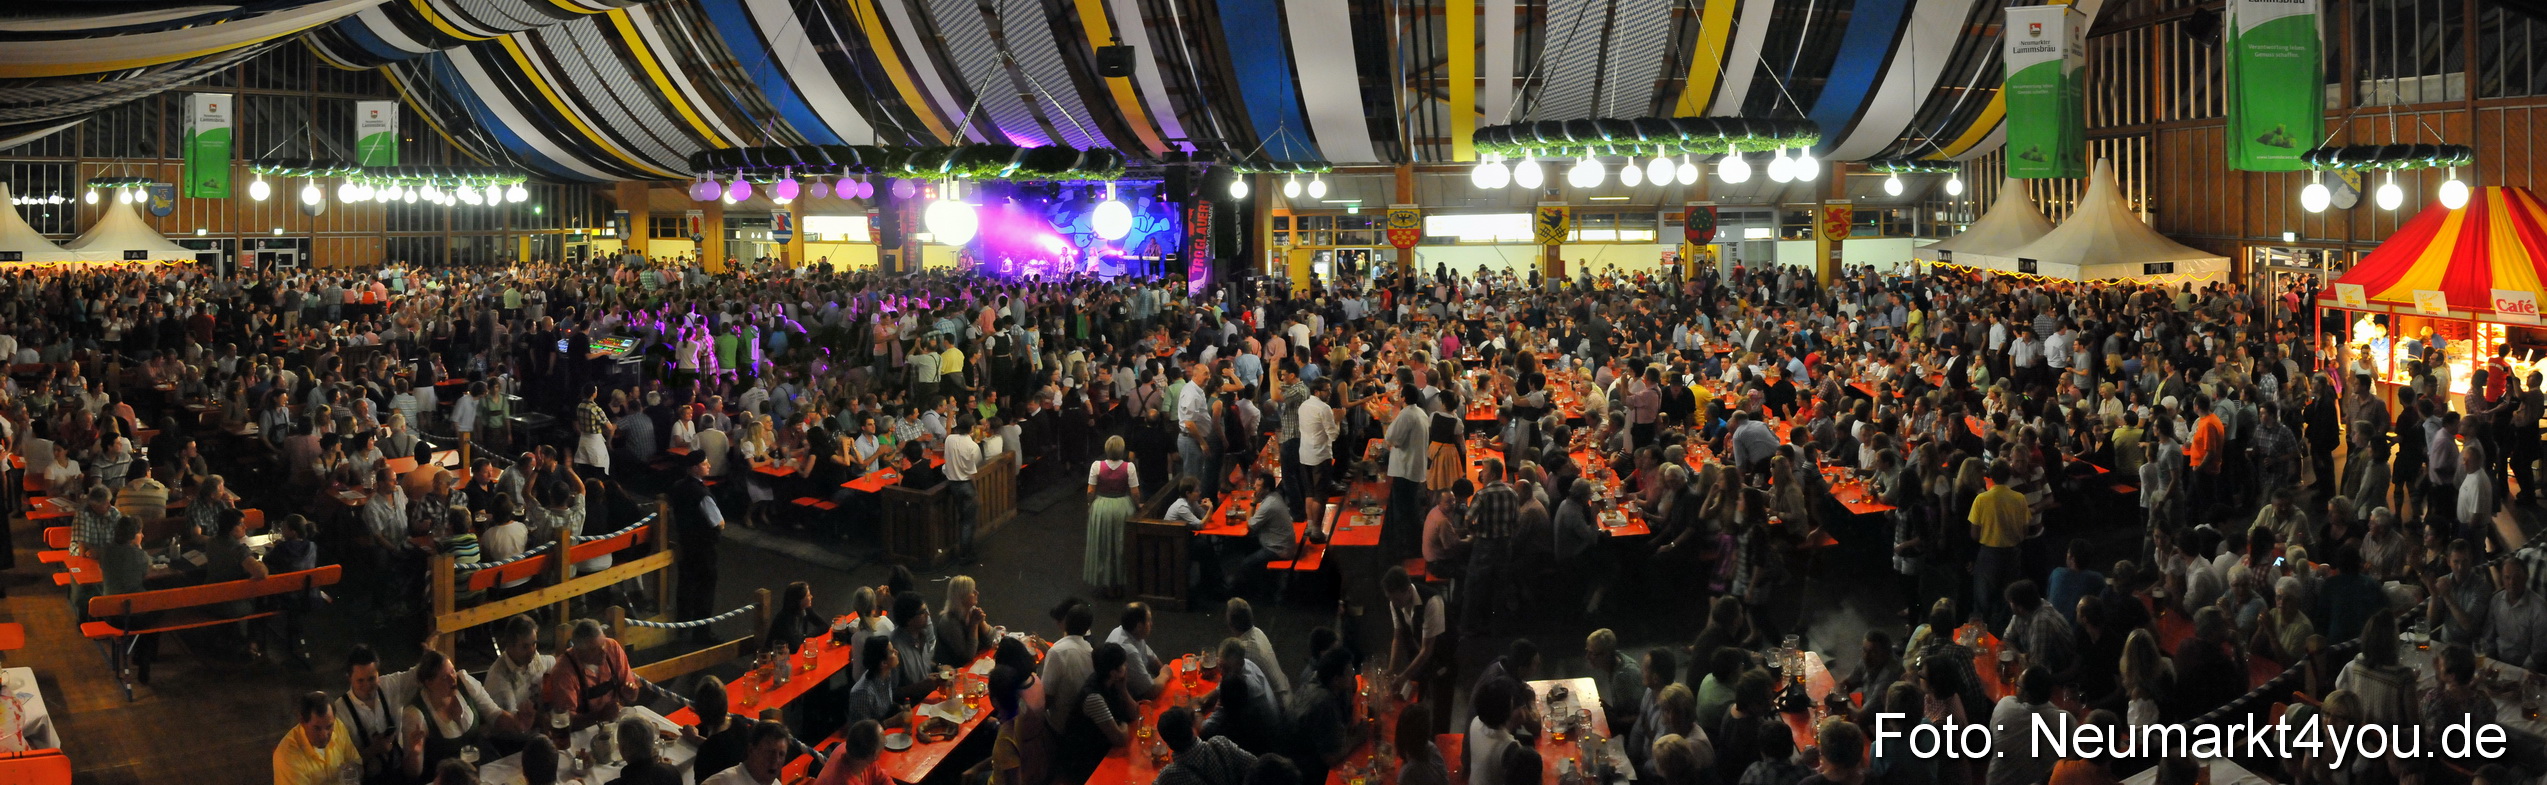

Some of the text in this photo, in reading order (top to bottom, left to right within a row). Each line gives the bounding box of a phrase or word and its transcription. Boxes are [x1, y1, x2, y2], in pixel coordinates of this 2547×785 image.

[2013, 45, 2056, 54] Lammsbräu
[2150, 263, 2168, 274] PILS
[2496, 298, 2535, 313] Café
